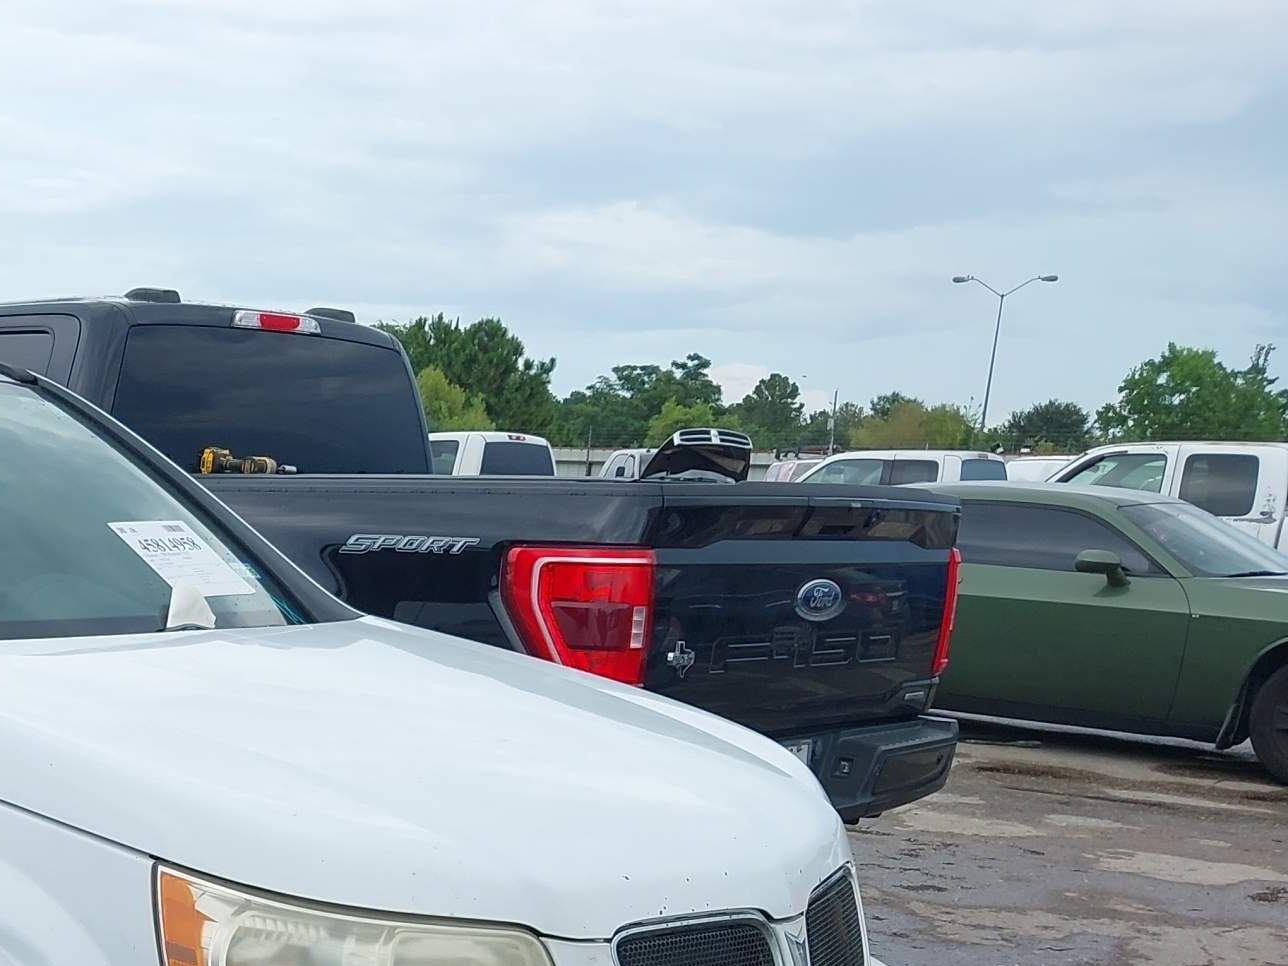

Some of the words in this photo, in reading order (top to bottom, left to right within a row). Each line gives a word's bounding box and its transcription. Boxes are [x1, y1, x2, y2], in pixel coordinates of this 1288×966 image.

[137, 536, 202, 553] 45814958
[339, 533, 481, 555] SPORT
[809, 586, 836, 608] Ford
